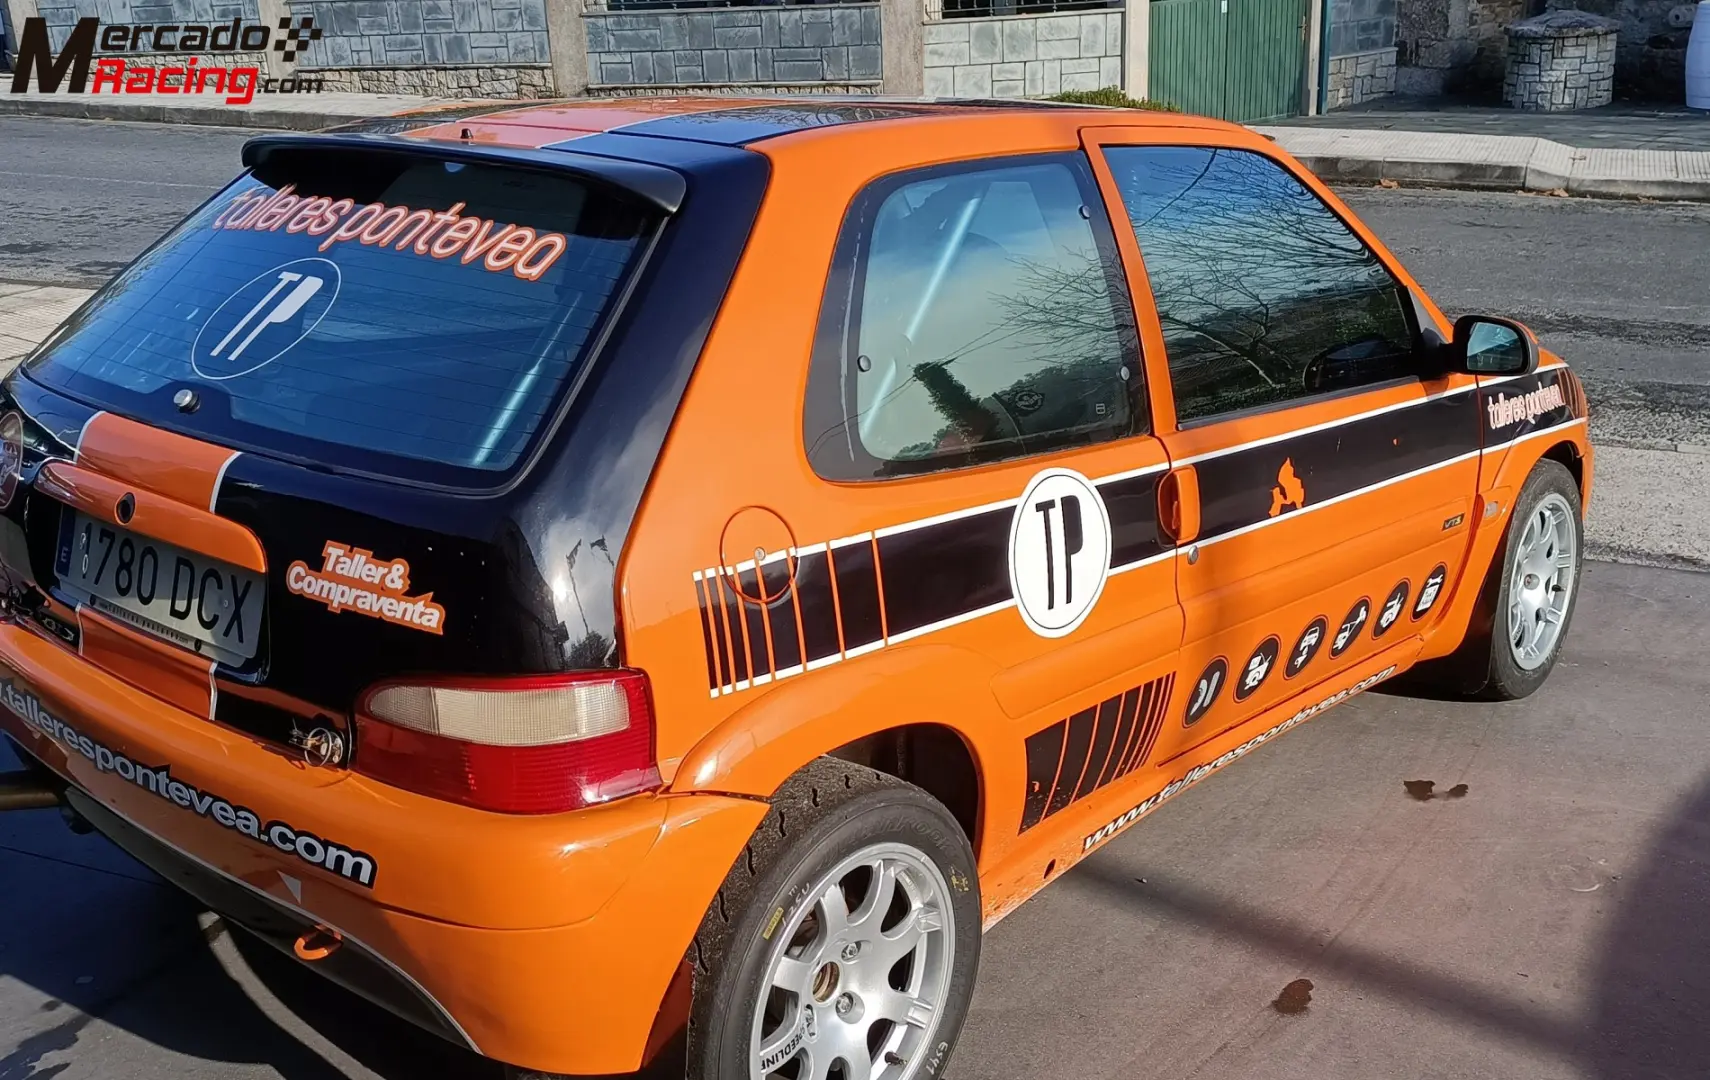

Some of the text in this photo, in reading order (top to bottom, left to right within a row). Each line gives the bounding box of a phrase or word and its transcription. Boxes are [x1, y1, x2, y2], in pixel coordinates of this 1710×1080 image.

[318, 202, 567, 281] pontevea
[210, 271, 324, 361] TP
[82, 521, 253, 644] 1780 DCX
[289, 565, 441, 629] Compraventa
[1035, 494, 1084, 611] TP
[0, 682, 375, 885] .tallerespontevea.com
